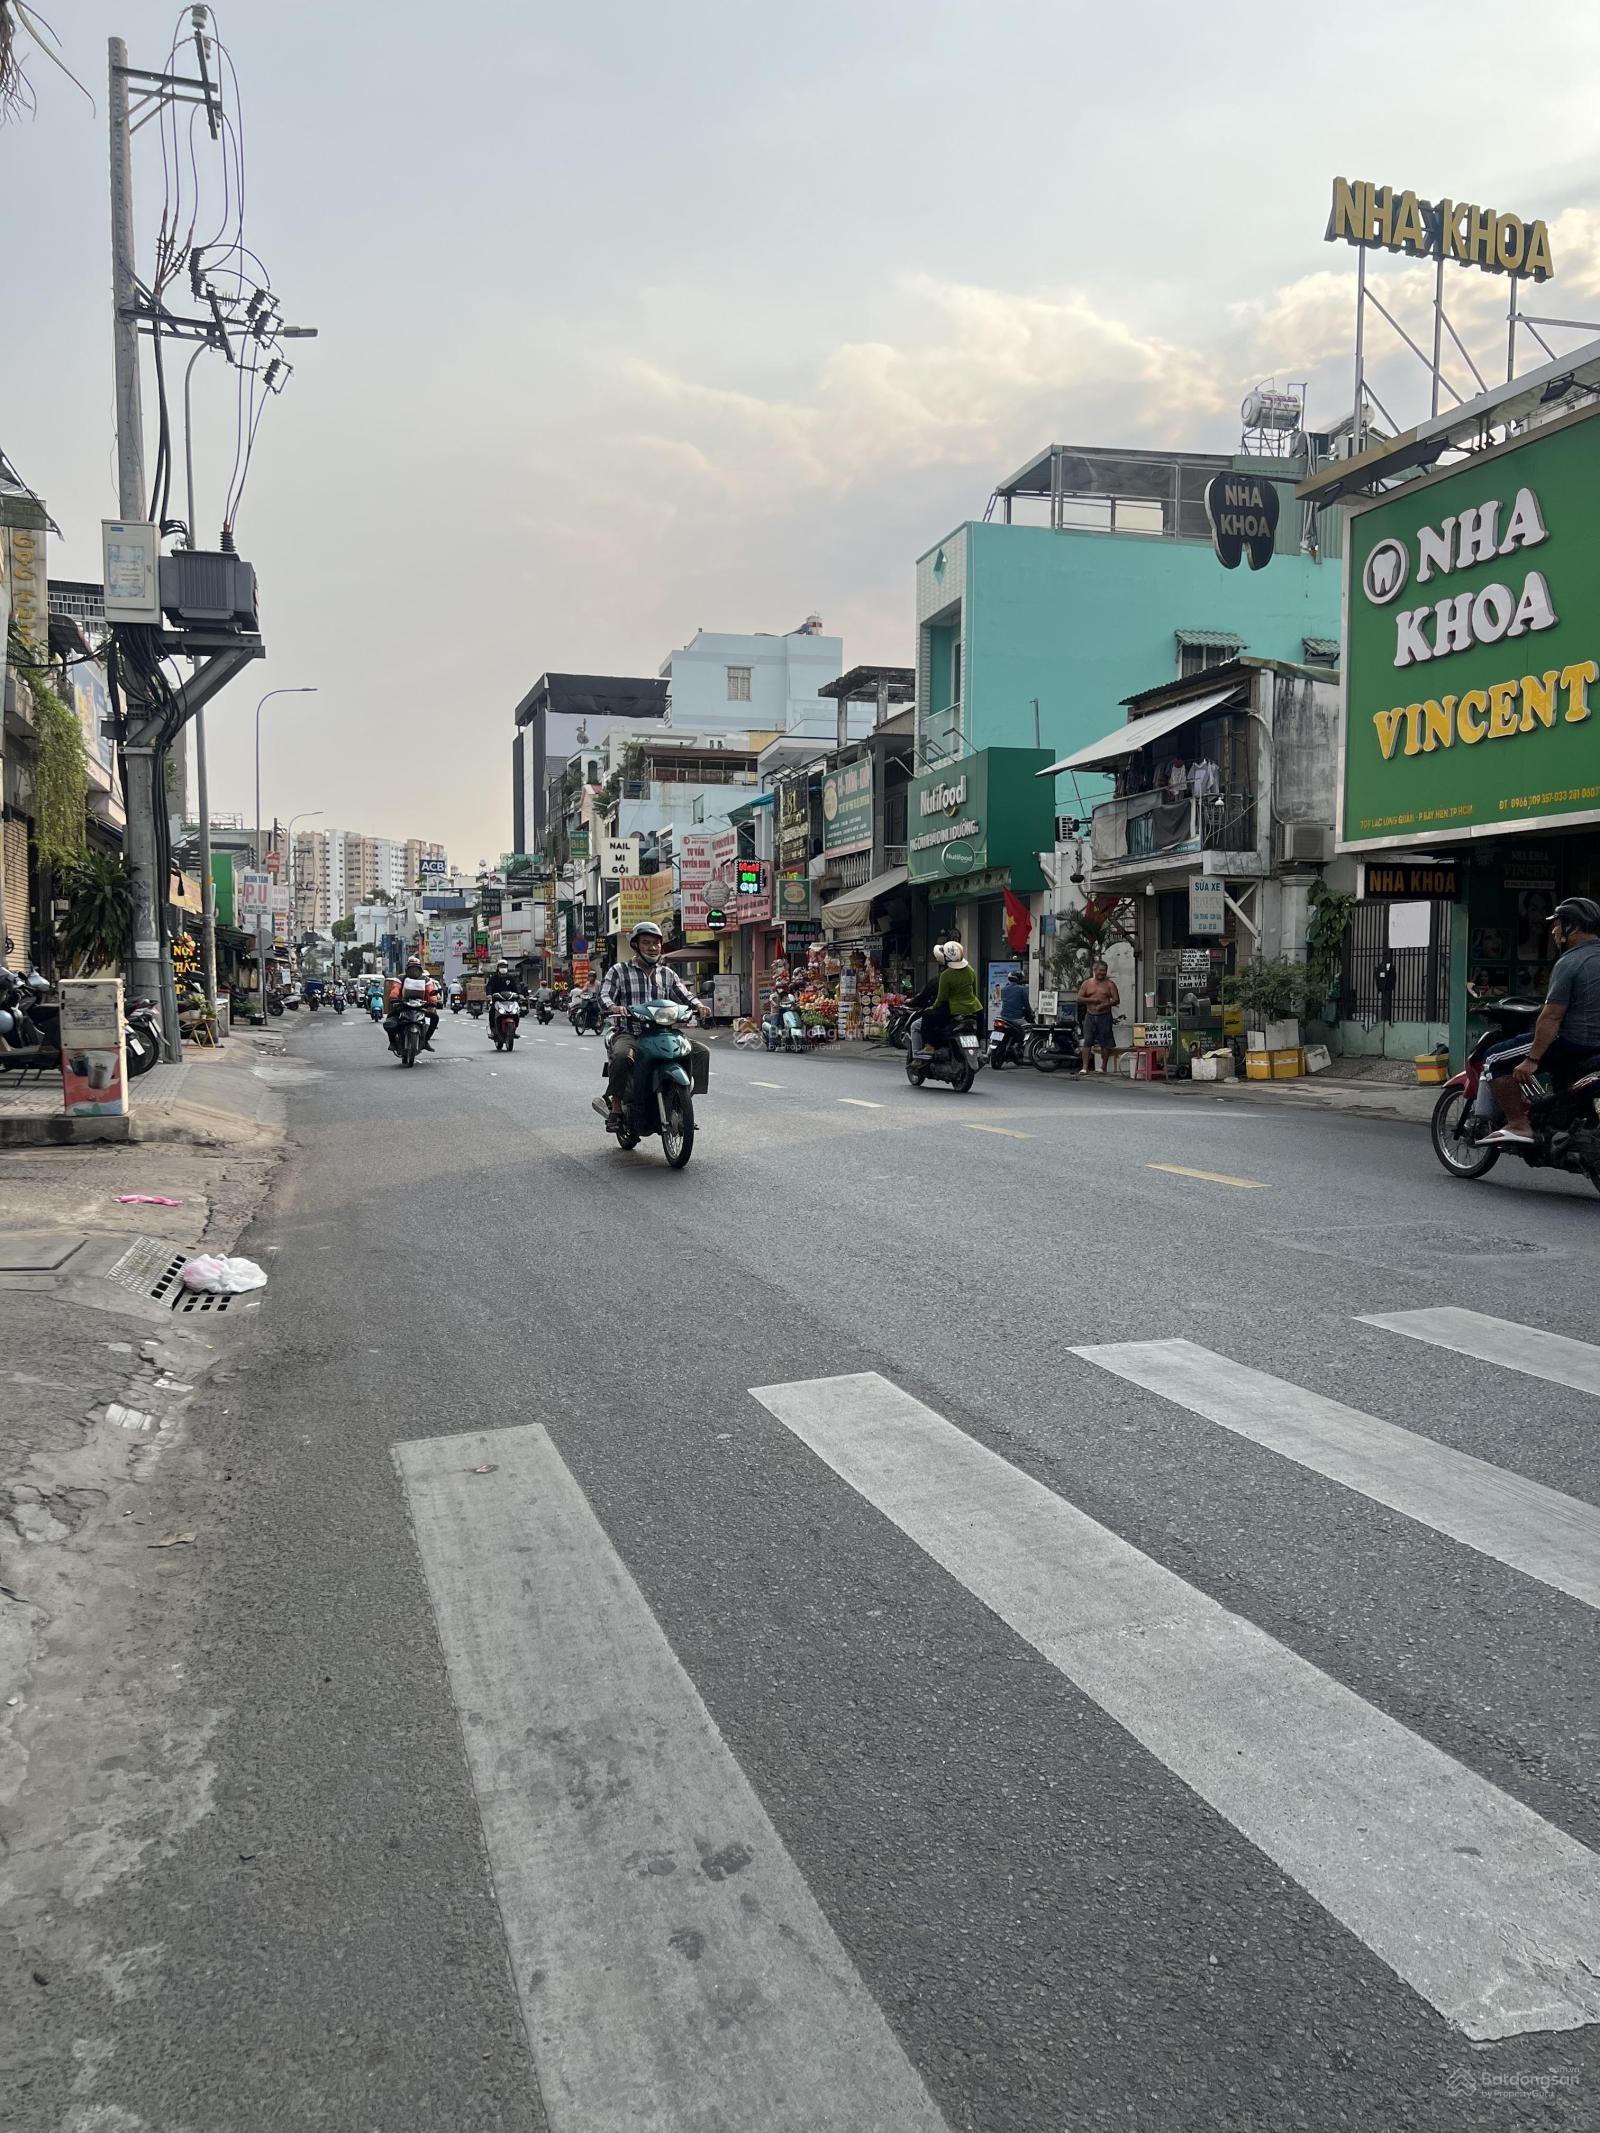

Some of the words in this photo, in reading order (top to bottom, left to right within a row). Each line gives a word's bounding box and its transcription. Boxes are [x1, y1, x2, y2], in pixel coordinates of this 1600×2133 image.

[1326, 176, 1426, 257] NHA
[1438, 198, 1555, 282] KHOA
[1224, 484, 1264, 508] NHA
[1220, 515, 1270, 539] KHOA
[1416, 487, 1549, 583] NHA
[1393, 571, 1559, 667] KHOA
[1372, 660, 1600, 760] VINCENT
[920, 775, 967, 816] Nutifood
[421, 860, 445, 872] ACB
[612, 864, 628, 875] GỘI
[946, 853, 972, 863] Nutifood
[622, 878, 648, 891] INOX
[1194, 879, 1210, 892] SỬA
[1212, 882, 1221, 892] XE
[1369, 870, 1404, 892] NHA
[1410, 871, 1456, 894] KHOA
[554, 982, 568, 990] CNC
